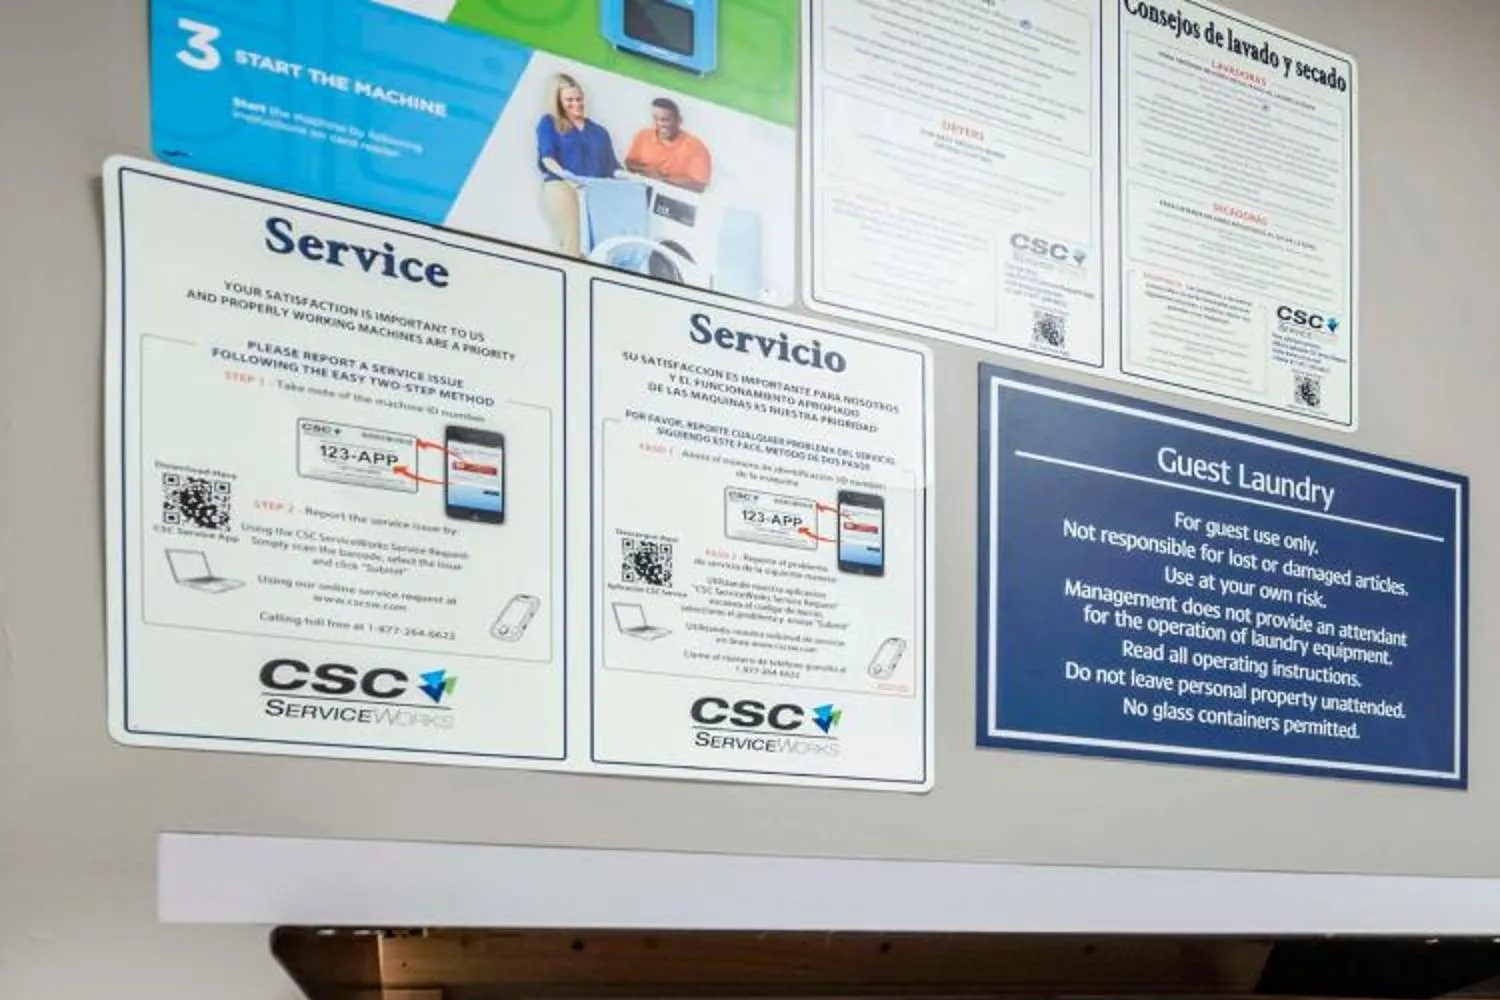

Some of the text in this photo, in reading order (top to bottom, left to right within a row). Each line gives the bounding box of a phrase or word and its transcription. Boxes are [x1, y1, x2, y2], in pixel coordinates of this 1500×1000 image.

[176, 17, 221, 72] 3
[1124, 0, 1347, 92] Consejos de lavado y secado
[235, 49, 447, 117] START THE MACHINE
[265, 216, 449, 288] Service
[1010, 233, 1069, 260] CSC
[187, 289, 217, 304] AND
[220, 295, 291, 318] PROPERLY
[292, 309, 355, 331] WORKING
[358, 322, 422, 344] MACHINES
[426, 335, 448, 349] ARE
[451, 340, 460, 351] A
[224, 281, 484, 342] YOUR SATISFACTION IS IMPORTANT TO US
[1277, 305, 1323, 328] CSC
[248, 340, 464, 389] PLEASE REPORT A SERVICE ISSUE
[689, 312, 847, 373] Servicio
[212, 348, 494, 407] FOLLOWING THE EASY TWO-STEP METHOD
[319, 444, 399, 466] 123-APP
[1157, 447, 1335, 511] Guest Laundry
[742, 509, 803, 528] 123-APP
[1174, 512, 1318, 556] For guest use only.
[1064, 520, 1408, 595] Not responsible for lost or damaged articles.
[1065, 579, 1406, 646] Management does not provide an attendant
[1165, 567, 1326, 608] Use at your own risk.
[1084, 606, 1392, 665] for the operation of laundry equipment.
[1122, 640, 1361, 687] Read all operating instructions.
[259, 658, 408, 699] CSC
[1066, 661, 1406, 718] Do not leave personal property unattended.
[691, 697, 804, 730] CSC
[1124, 699, 1360, 738] No glass containers permitted.
